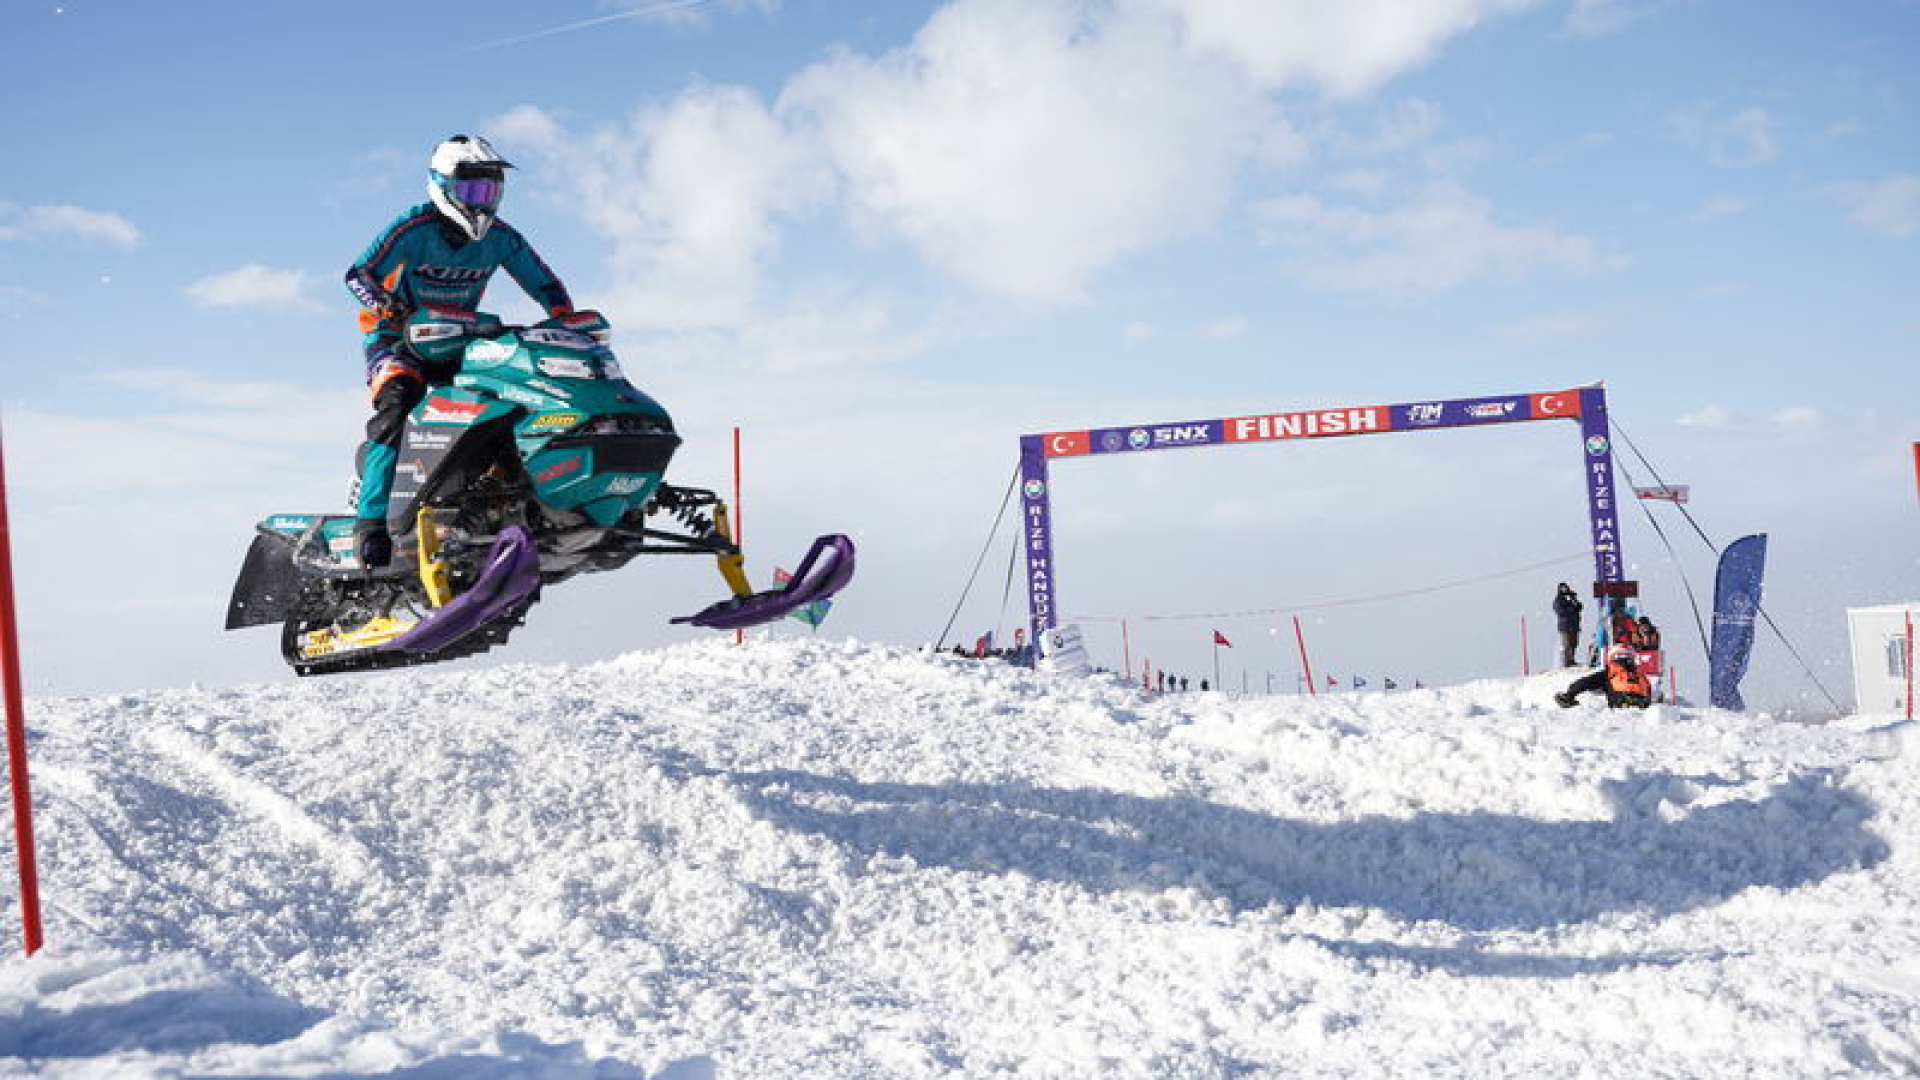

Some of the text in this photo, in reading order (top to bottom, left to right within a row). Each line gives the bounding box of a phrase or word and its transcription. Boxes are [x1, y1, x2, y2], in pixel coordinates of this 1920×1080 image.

[1154, 424, 1210, 442] SNX
[1235, 409, 1377, 440] FINISH
[1593, 462, 1609, 510] RIZE
[1030, 506, 1043, 549] RIZE
